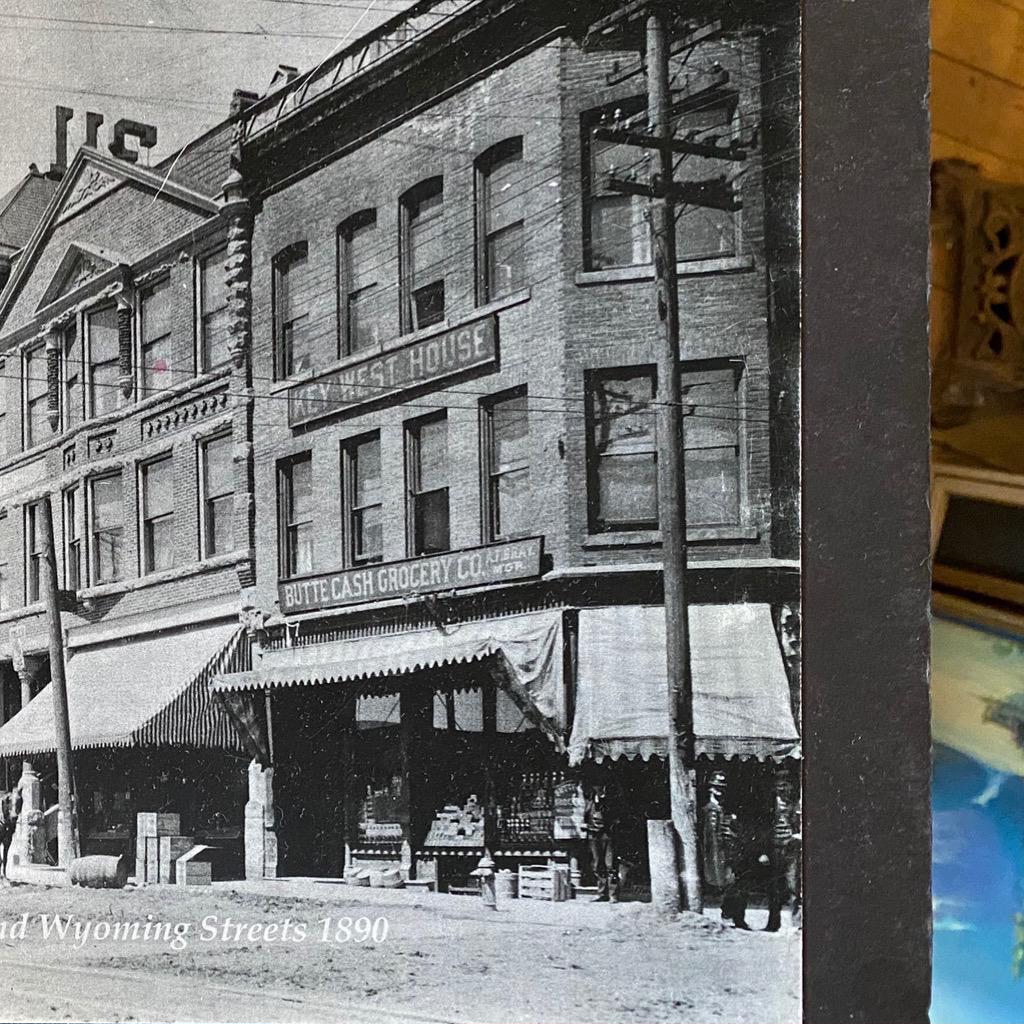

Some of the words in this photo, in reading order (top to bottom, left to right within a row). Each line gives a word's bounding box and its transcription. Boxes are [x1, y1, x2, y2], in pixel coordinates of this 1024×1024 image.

[409, 323, 488, 378] HOUSE
[284, 578, 328, 607] BUTTE
[330, 570, 374, 600] CASH
[378, 558, 453, 592] GROCERY
